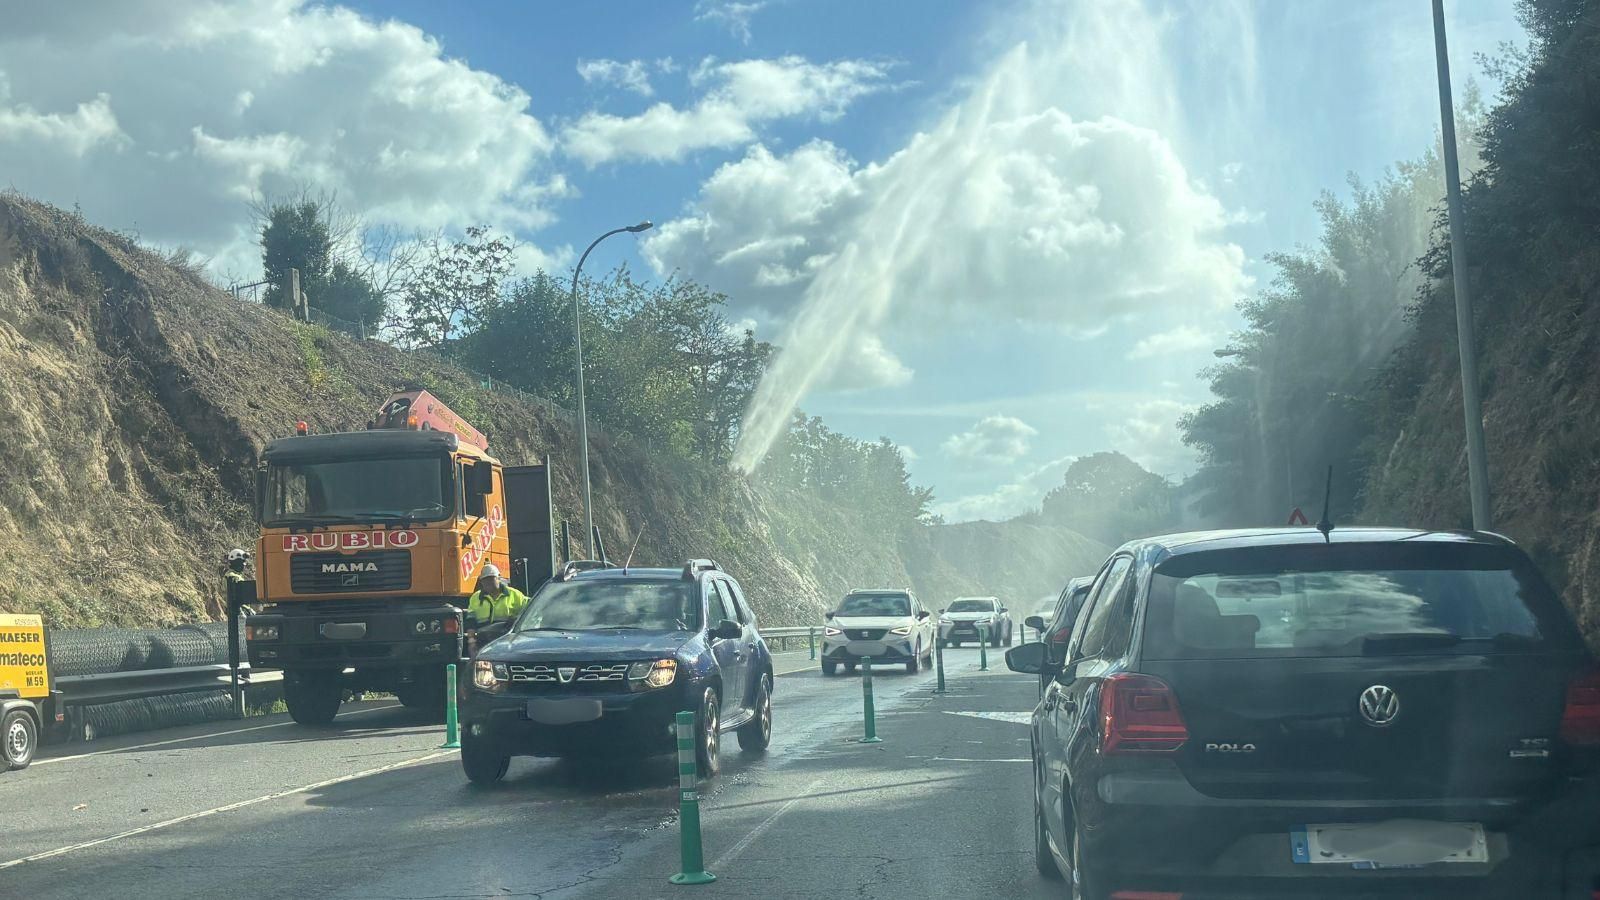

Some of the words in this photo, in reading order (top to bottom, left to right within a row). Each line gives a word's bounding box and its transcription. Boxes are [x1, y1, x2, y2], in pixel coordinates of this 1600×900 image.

[282, 530, 419, 552] RUBIO
[461, 504, 502, 581] RUBIO
[321, 562, 378, 573] MAMA
[0, 652, 44, 666] mateco
[26, 677, 33, 687] M
[34, 676, 44, 687] 59
[1206, 743, 1256, 753] POLO
